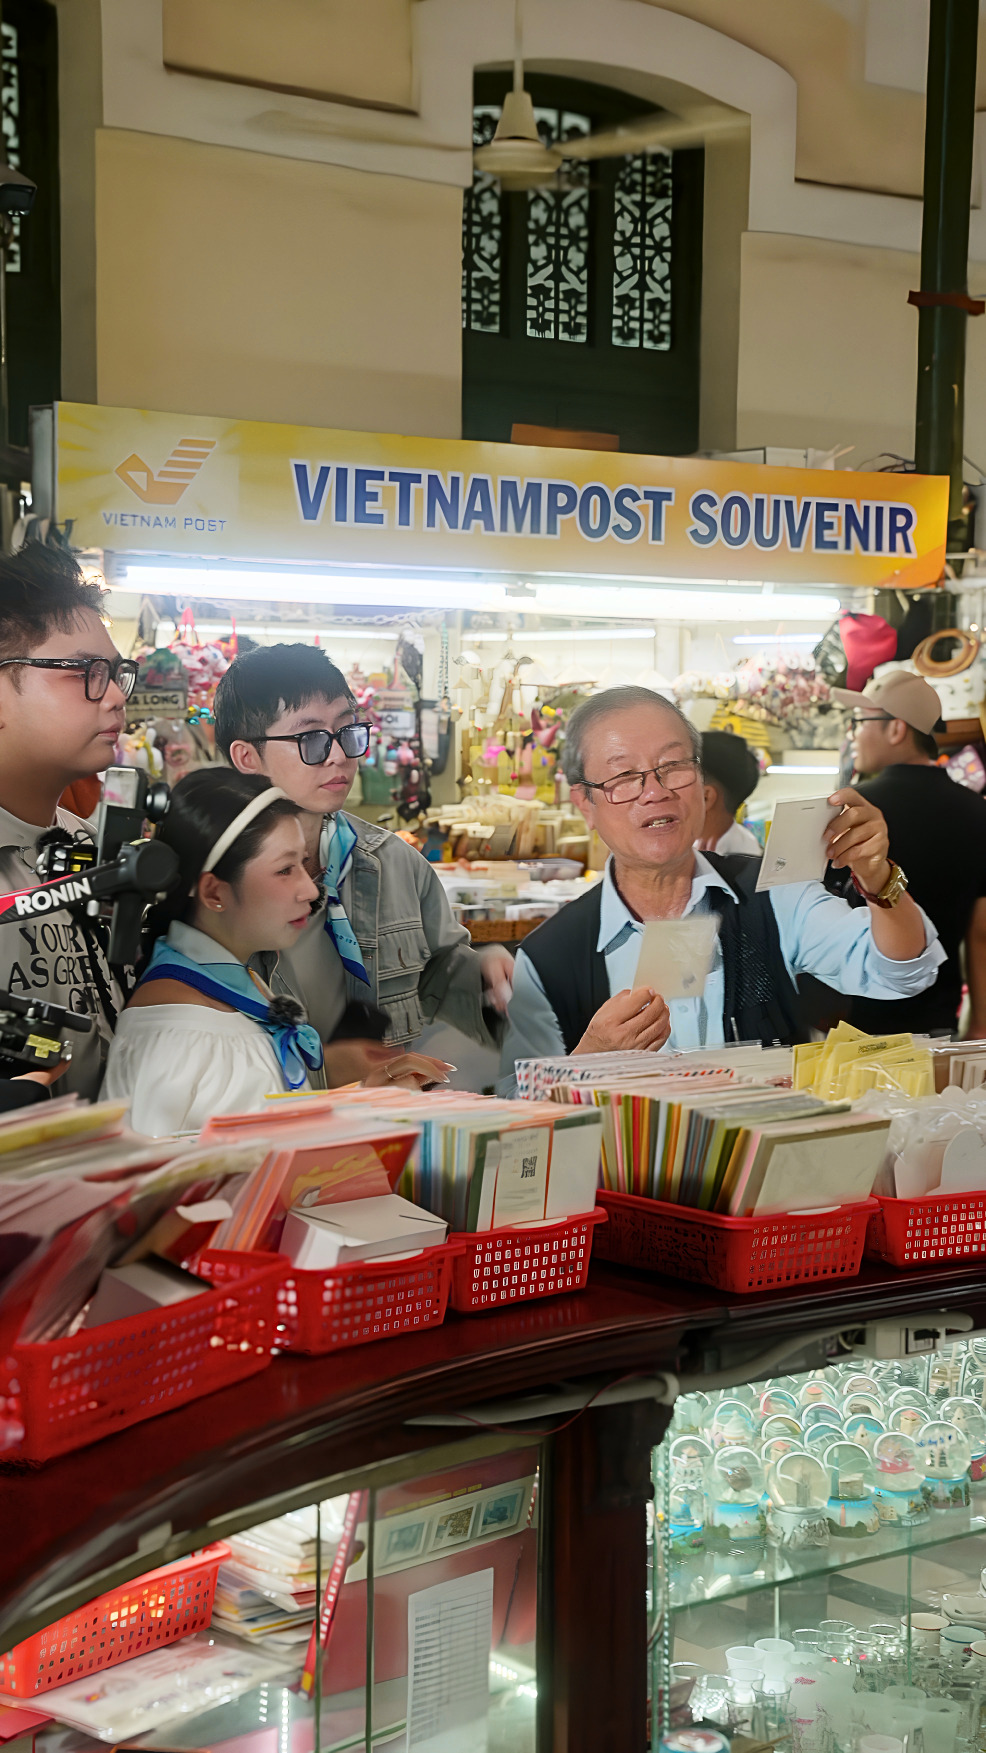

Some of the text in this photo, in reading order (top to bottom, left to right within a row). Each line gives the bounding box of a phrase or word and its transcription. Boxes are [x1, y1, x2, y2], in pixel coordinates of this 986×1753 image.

[102, 511, 227, 532] VIETNAM POST
[292, 461, 915, 555] VIETNAMPOST SOUVENIR
[143, 693, 179, 705] LONG
[14, 877, 92, 916] RONIN
[8, 957, 50, 994] AS
